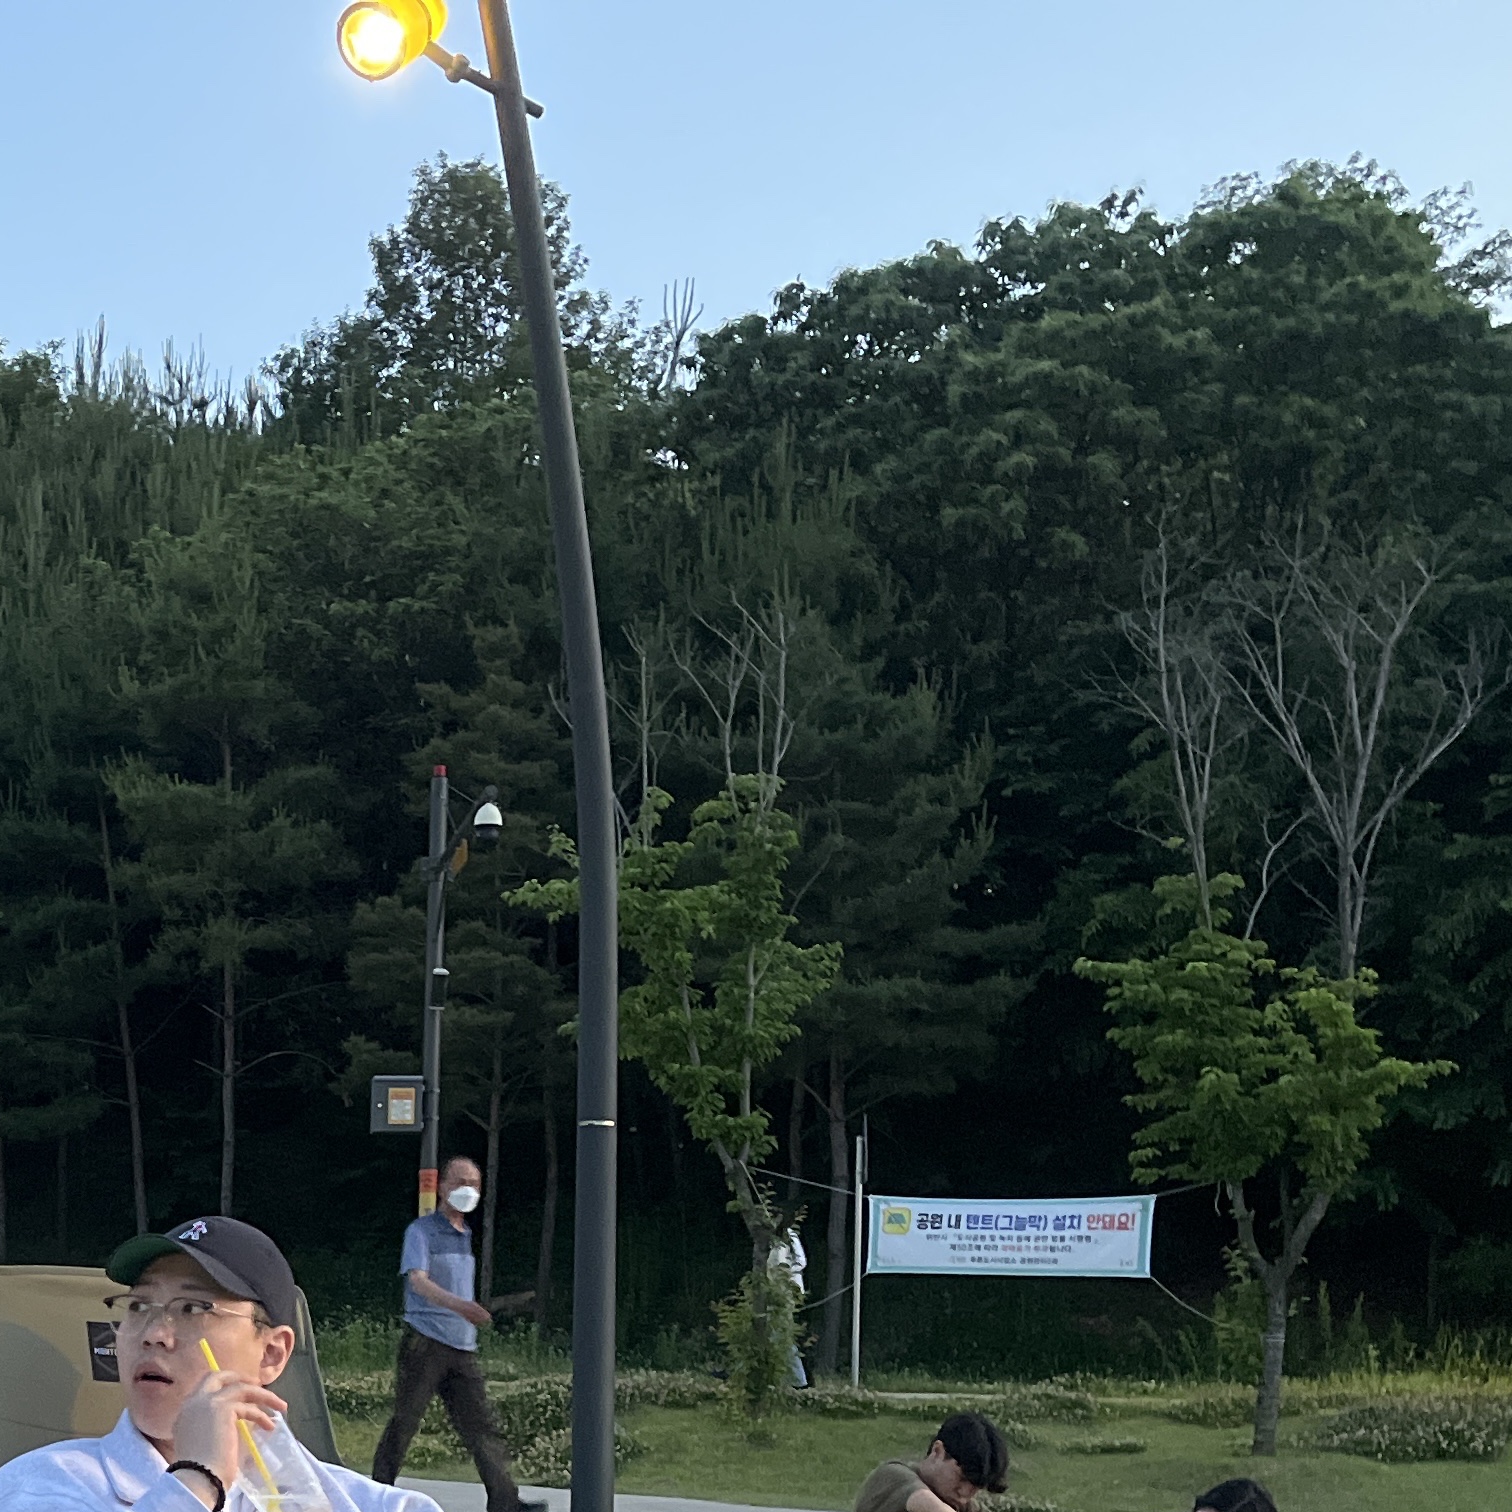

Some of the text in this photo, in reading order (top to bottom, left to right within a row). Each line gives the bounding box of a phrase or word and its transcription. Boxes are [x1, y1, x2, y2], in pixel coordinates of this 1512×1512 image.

[916, 1213, 943, 1230] 공원
[947, 1213, 962, 1230] 내
[966, 1213, 1048, 1231] 텐트(그늘막)
[1053, 1214, 1082, 1231] 설치
